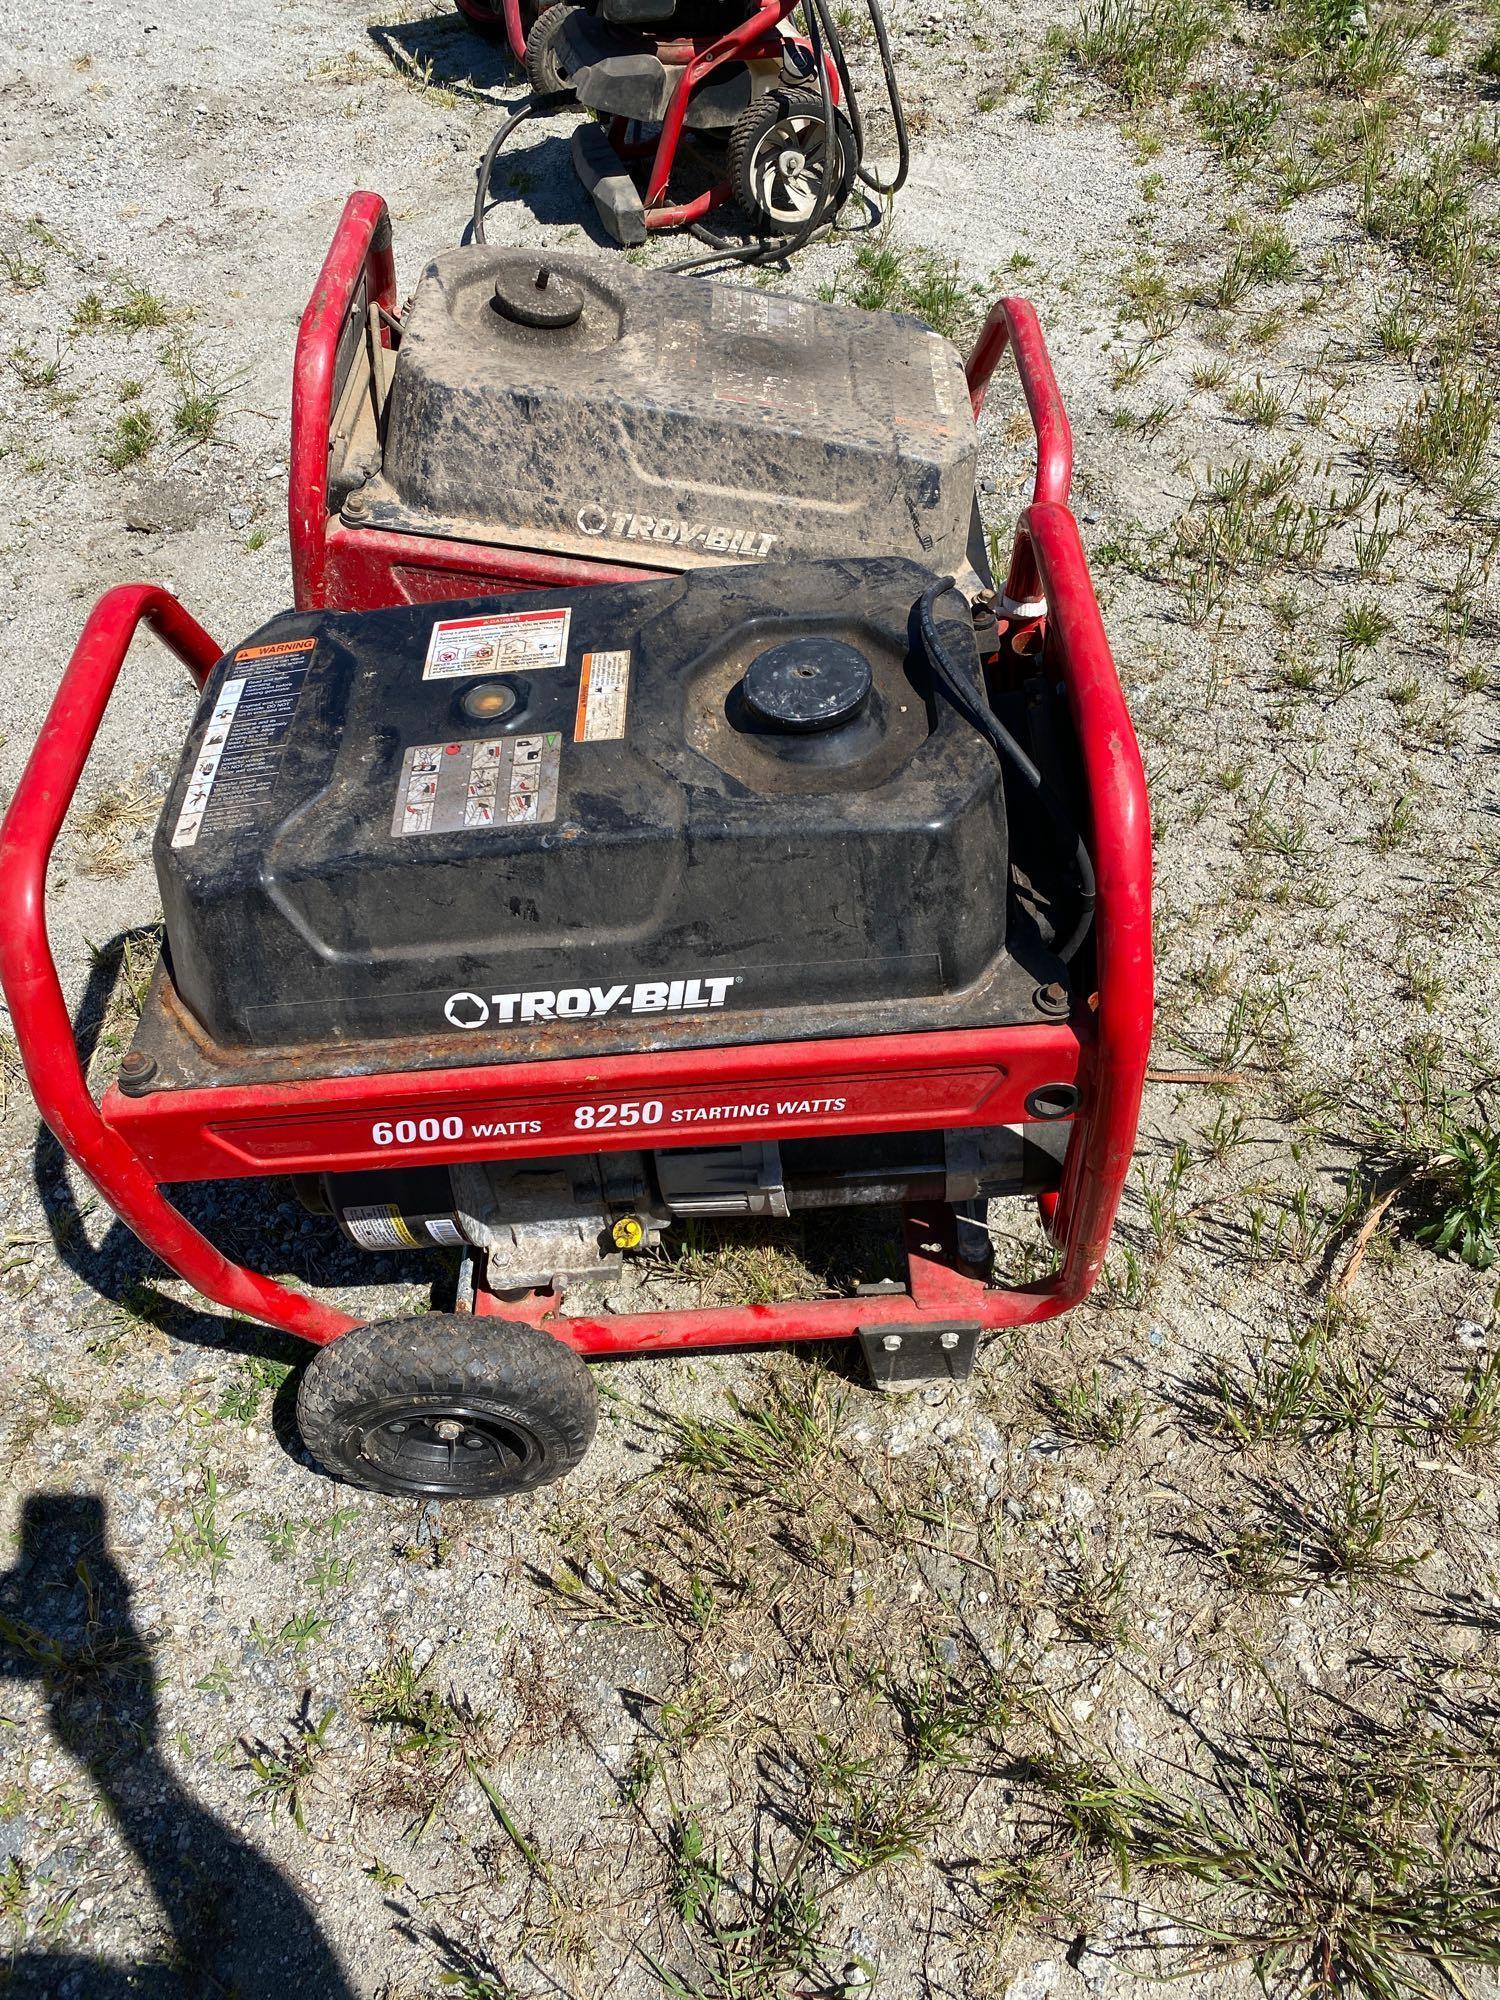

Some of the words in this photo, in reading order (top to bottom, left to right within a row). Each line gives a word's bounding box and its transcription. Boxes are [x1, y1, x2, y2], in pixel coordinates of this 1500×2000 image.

[611, 510, 779, 558] TROY-BILT
[259, 640, 312, 656] WARNING
[574, 1100, 664, 1130] 8250
[670, 1102, 770, 1122] STARTING
[776, 1097, 847, 1116] WATTS
[372, 1116, 464, 1146] 6000
[471, 1120, 542, 1137] WATTS
